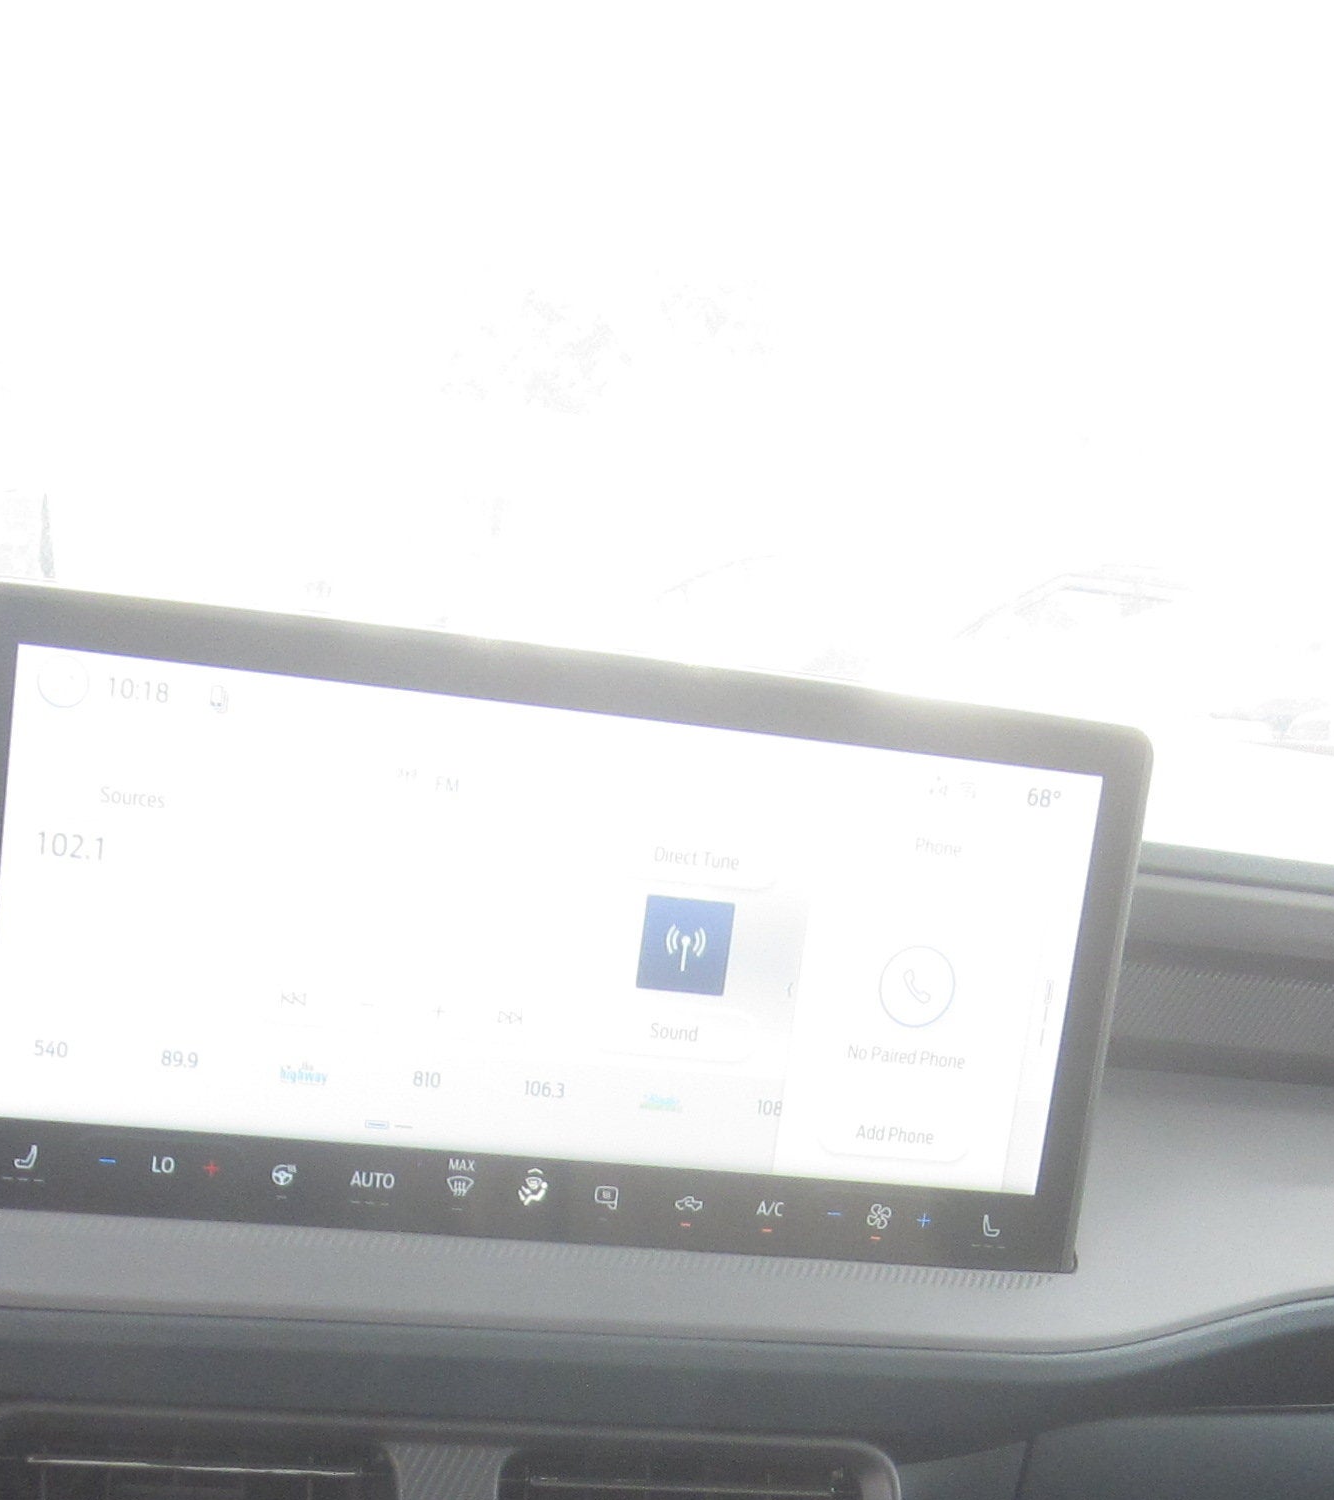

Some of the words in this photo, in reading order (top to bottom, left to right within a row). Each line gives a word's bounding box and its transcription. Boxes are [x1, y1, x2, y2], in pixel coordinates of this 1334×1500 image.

[107, 677, 170, 703] 10:18
[99, 785, 166, 809] Sources
[36, 830, 105, 861] 102.1
[915, 836, 962, 857] Phone
[654, 845, 698, 867] Direct
[703, 851, 740, 871] Tune
[650, 1023, 699, 1043] Sound
[34, 1039, 68, 1058] 540
[160, 1049, 199, 1069] 89.9
[847, 1043, 867, 1061] No
[871, 1045, 916, 1067] Paired
[919, 1050, 965, 1071] Phone
[412, 1070, 441, 1088] 810
[523, 1079, 565, 1099] 106.3
[855, 1123, 885, 1142] Add
[888, 1125, 934, 1145] Phone
[152, 1156, 175, 1173] LO
[448, 1159, 475, 1173] MAX
[350, 1170, 395, 1190] AUTO
[756, 1201, 784, 1217] A/C
